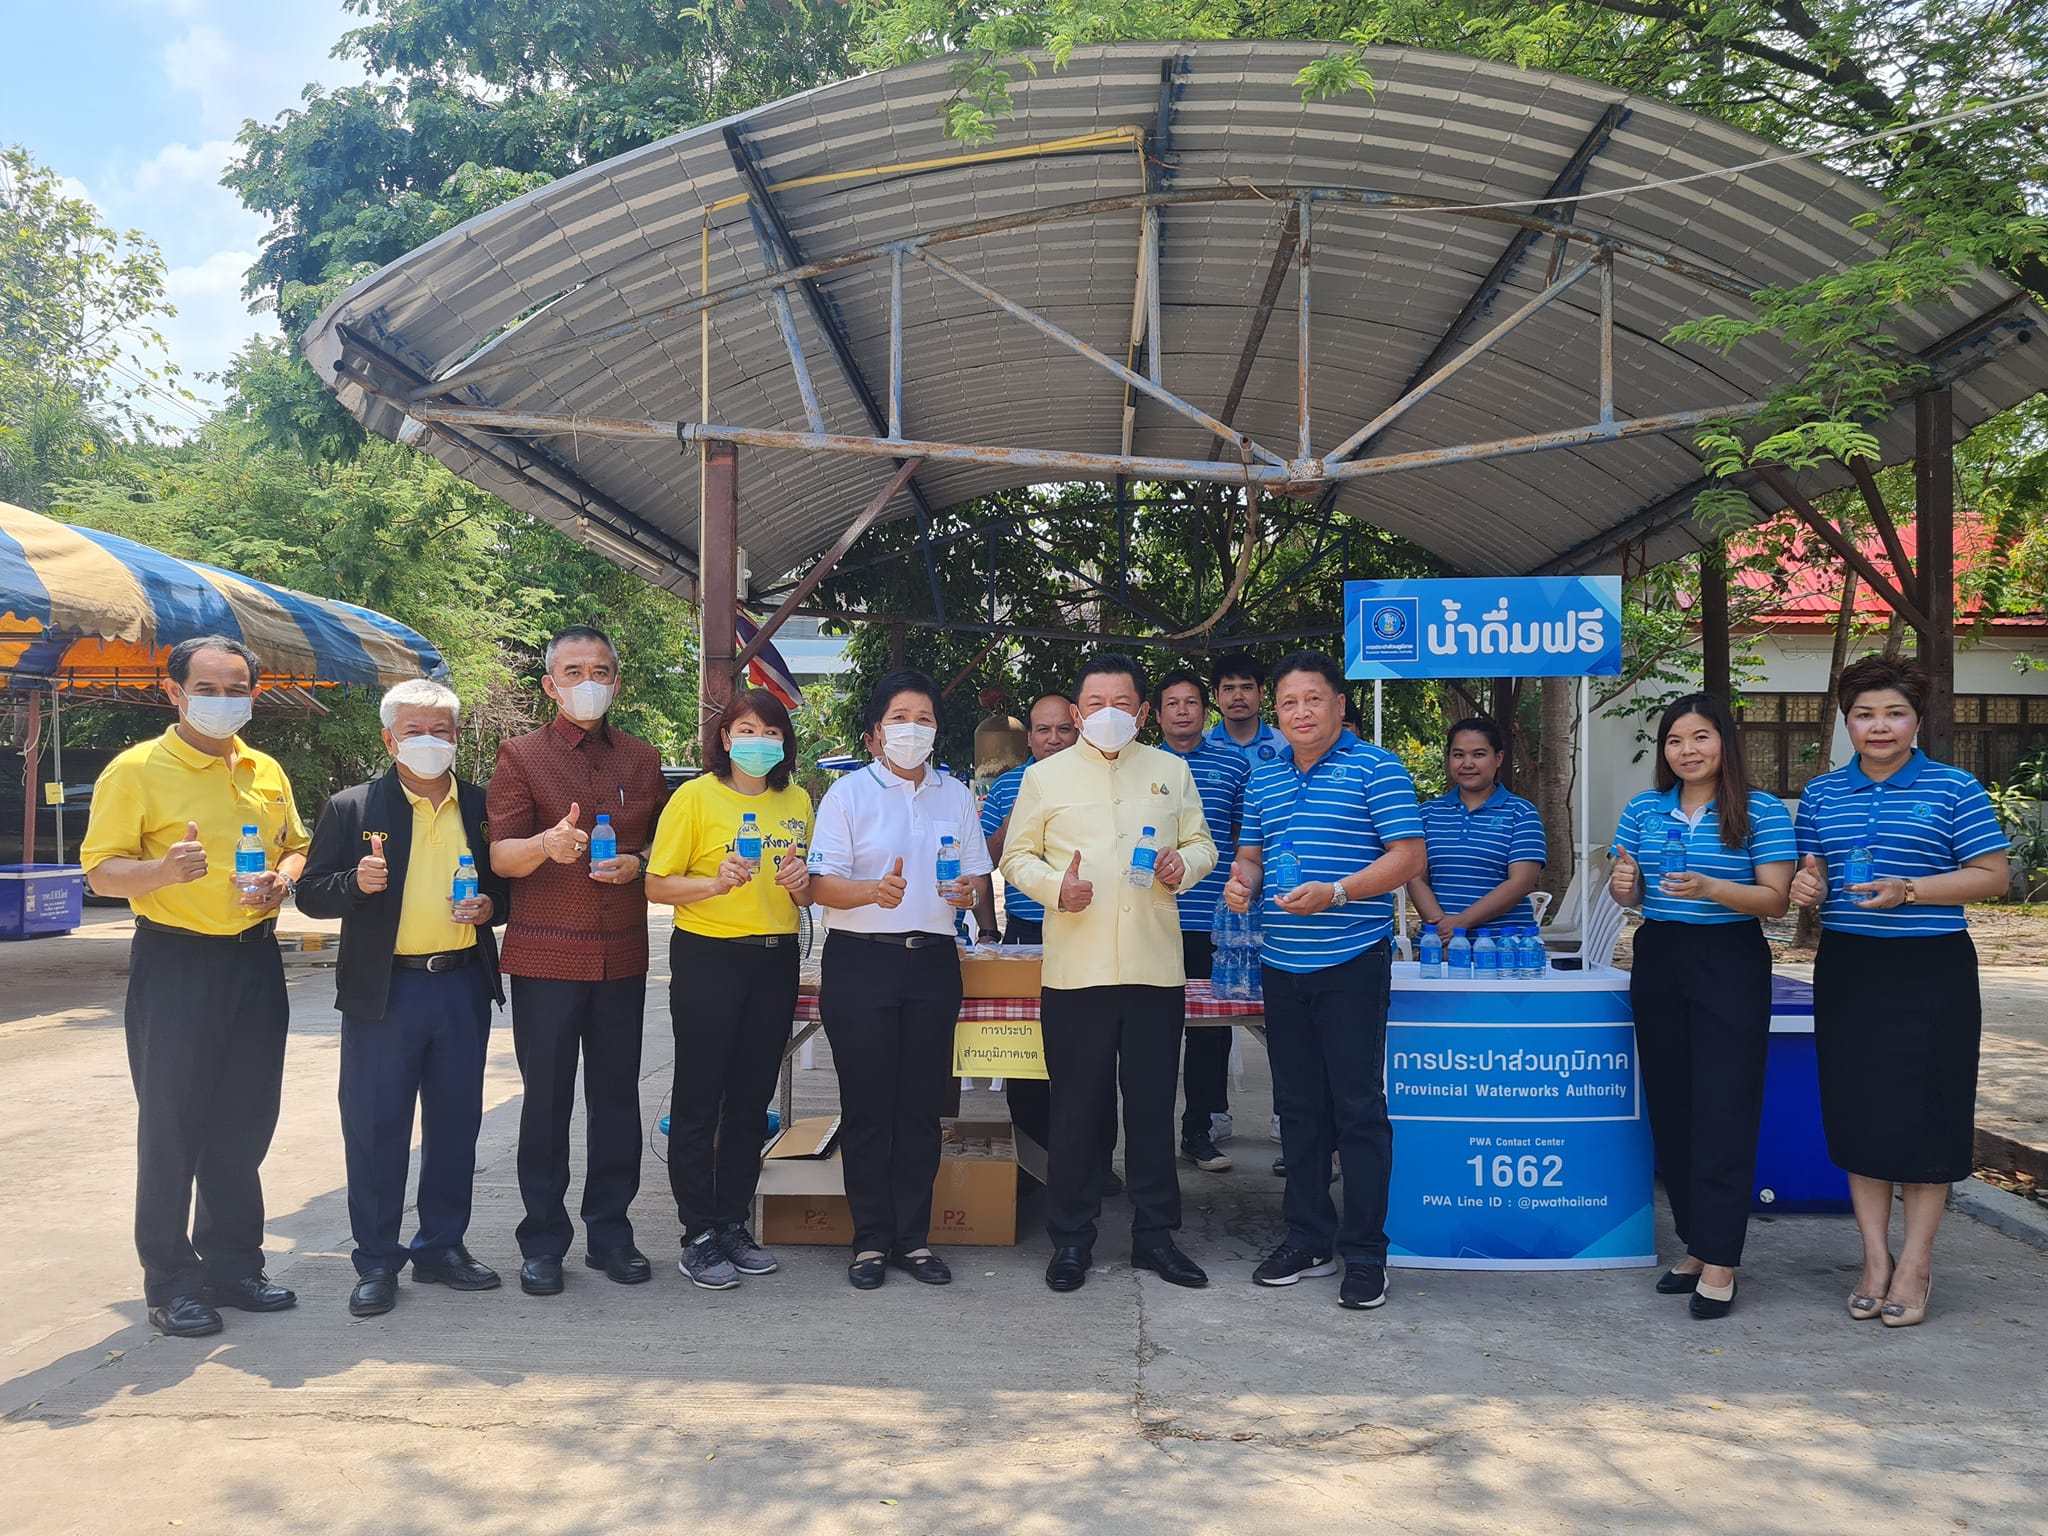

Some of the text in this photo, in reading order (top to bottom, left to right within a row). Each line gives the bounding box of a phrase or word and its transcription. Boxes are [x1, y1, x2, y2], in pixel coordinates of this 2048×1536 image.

[1427, 596, 1605, 655] น้ำดื่มฟรี
[981, 1024, 1033, 1036] การประปา
[963, 1046, 1038, 1062] ส่วนภูมิภาคเขต
[1393, 1048, 1629, 1078] การประปาส่วนภูมิภาค
[1395, 1082, 1627, 1098] Provincial Waterworks Authority
[1469, 1137, 1566, 1147] PWA Contact Center
[1466, 1154, 1564, 1188] 1662
[1423, 1195, 1452, 1207] PWA
[1457, 1196, 1484, 1208] Line
[1489, 1196, 1503, 1208] ID
[1517, 1195, 1608, 1210] @pwathailand
[804, 1209, 828, 1225] P2
[943, 1210, 966, 1225] P2
